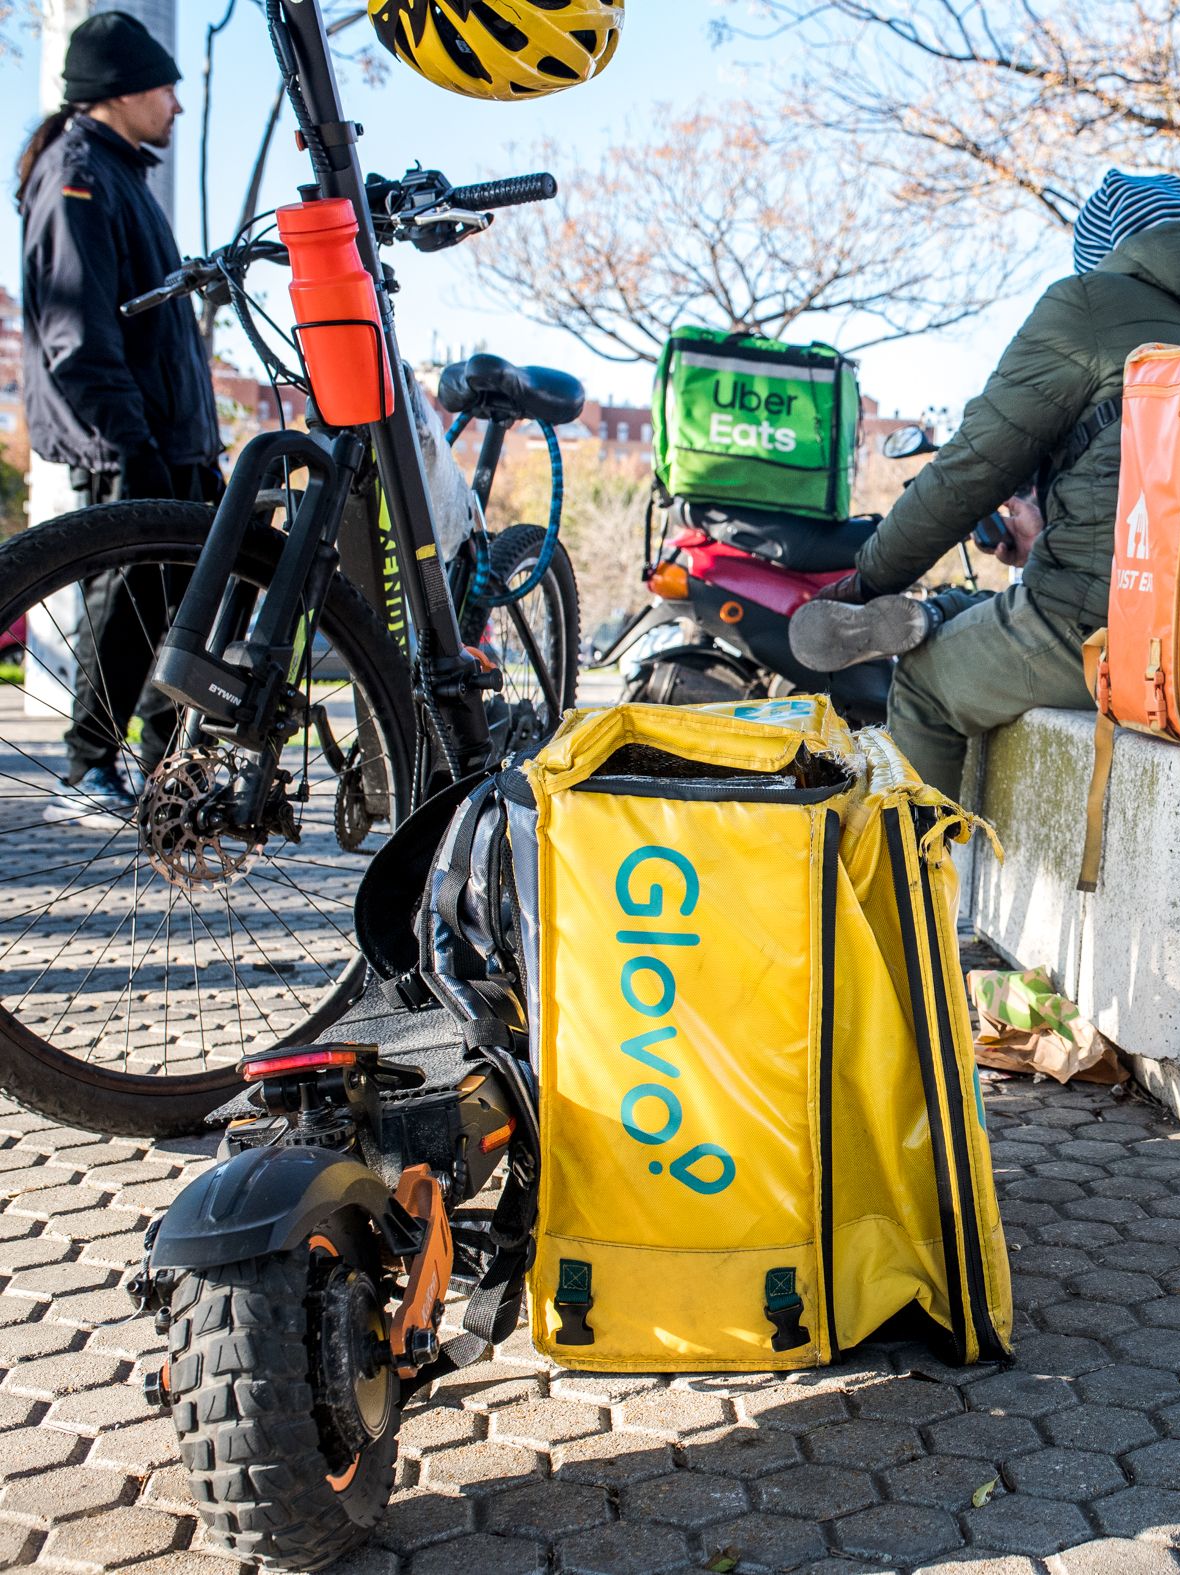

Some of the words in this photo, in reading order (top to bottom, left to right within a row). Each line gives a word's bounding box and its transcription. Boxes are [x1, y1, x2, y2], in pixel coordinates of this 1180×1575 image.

[713, 379, 798, 416] Uber
[709, 412, 797, 452] Eats
[615, 845, 700, 1146] Glovo
